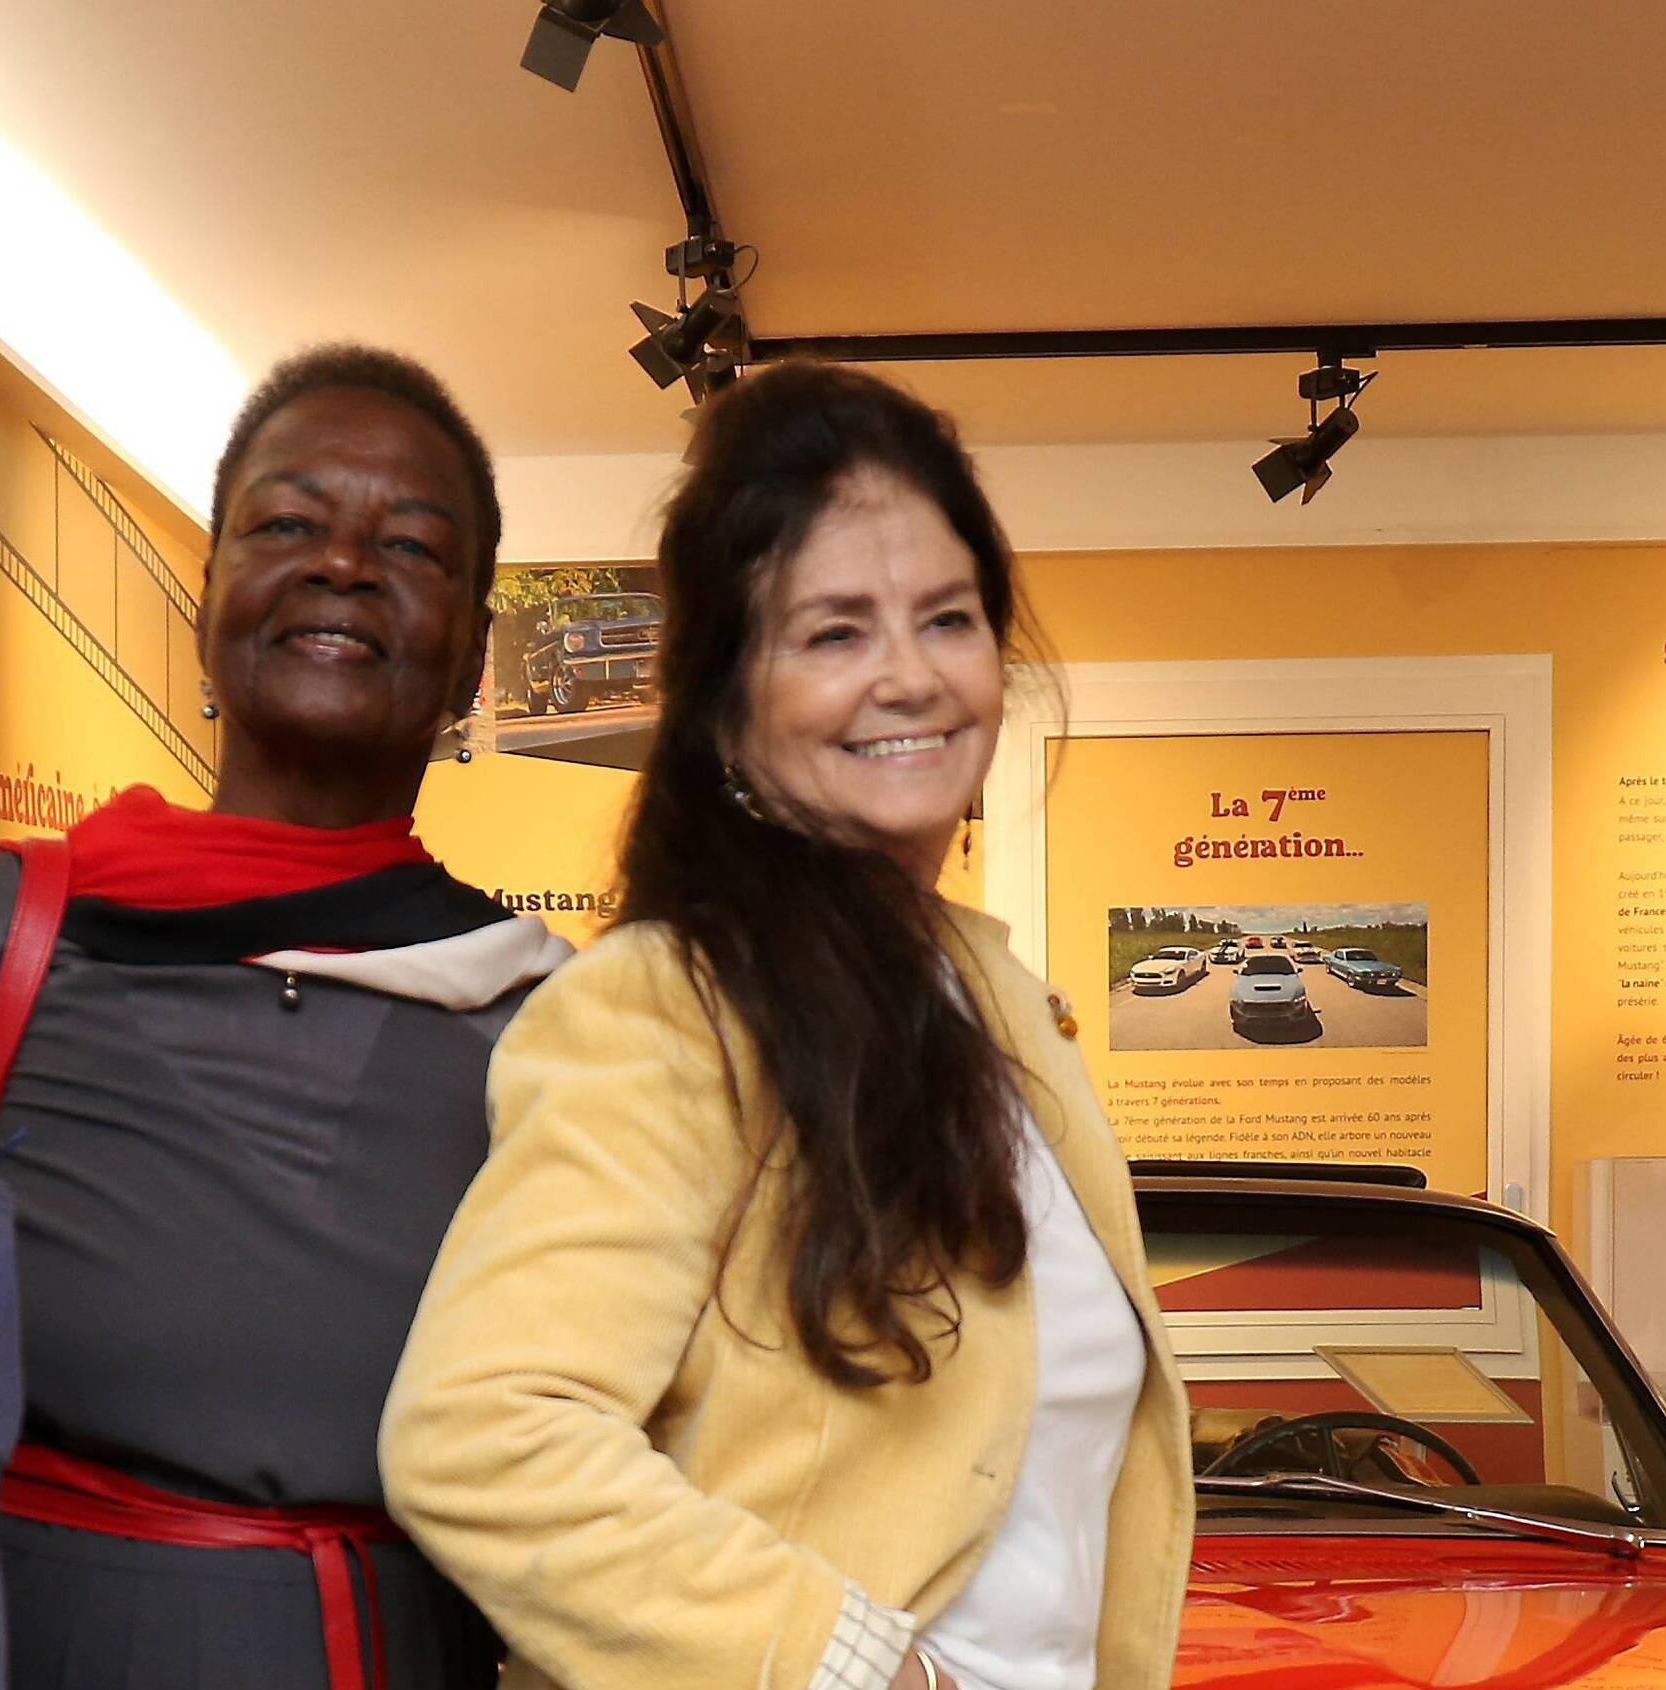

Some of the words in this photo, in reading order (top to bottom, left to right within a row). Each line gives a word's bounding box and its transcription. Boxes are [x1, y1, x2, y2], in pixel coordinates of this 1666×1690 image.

[1619, 776, 1647, 787] Après
[1211, 792, 1249, 817] La
[1174, 831, 1364, 868] génération...
[1618, 907, 1630, 917] de
[1645, 1033, 1658, 1044] de
[1616, 1052, 1634, 1063] des
[1638, 1052, 1659, 1064] plus
[1107, 1079, 1119, 1089] La
[1125, 1079, 1166, 1090] Mustang
[1172, 1078, 1205, 1088] évolue
[1210, 1079, 1231, 1087] avec
[1236, 1079, 1254, 1087] son
[1259, 1078, 1289, 1088] temps
[1295, 1077, 1307, 1086] en
[1312, 1076, 1361, 1088] proposant
[1367, 1075, 1384, 1085] des
[1389, 1074, 1431, 1085] modèles
[1116, 1097, 1150, 1107] travers
[1153, 1114, 1206, 1127] génération
[1210, 1113, 1222, 1124] de
[1239, 1114, 1262, 1123] Ford
[1265, 1113, 1307, 1125] Mustang
[1311, 1114, 1326, 1123] est
[1330, 1112, 1363, 1123] arrivée
[1367, 1112, 1380, 1122] 60
[1384, 1113, 1401, 1122] ans
[1405, 1111, 1431, 1123] après
[1318, 1130, 1336, 1140] elle
[1339, 1130, 1371, 1140] arbore
[1374, 1131, 1386, 1140] un
[1389, 1131, 1431, 1140] nouveau
[1349, 1148, 1381, 1158] nouvel
[1386, 1147, 1431, 1158] habitacle
